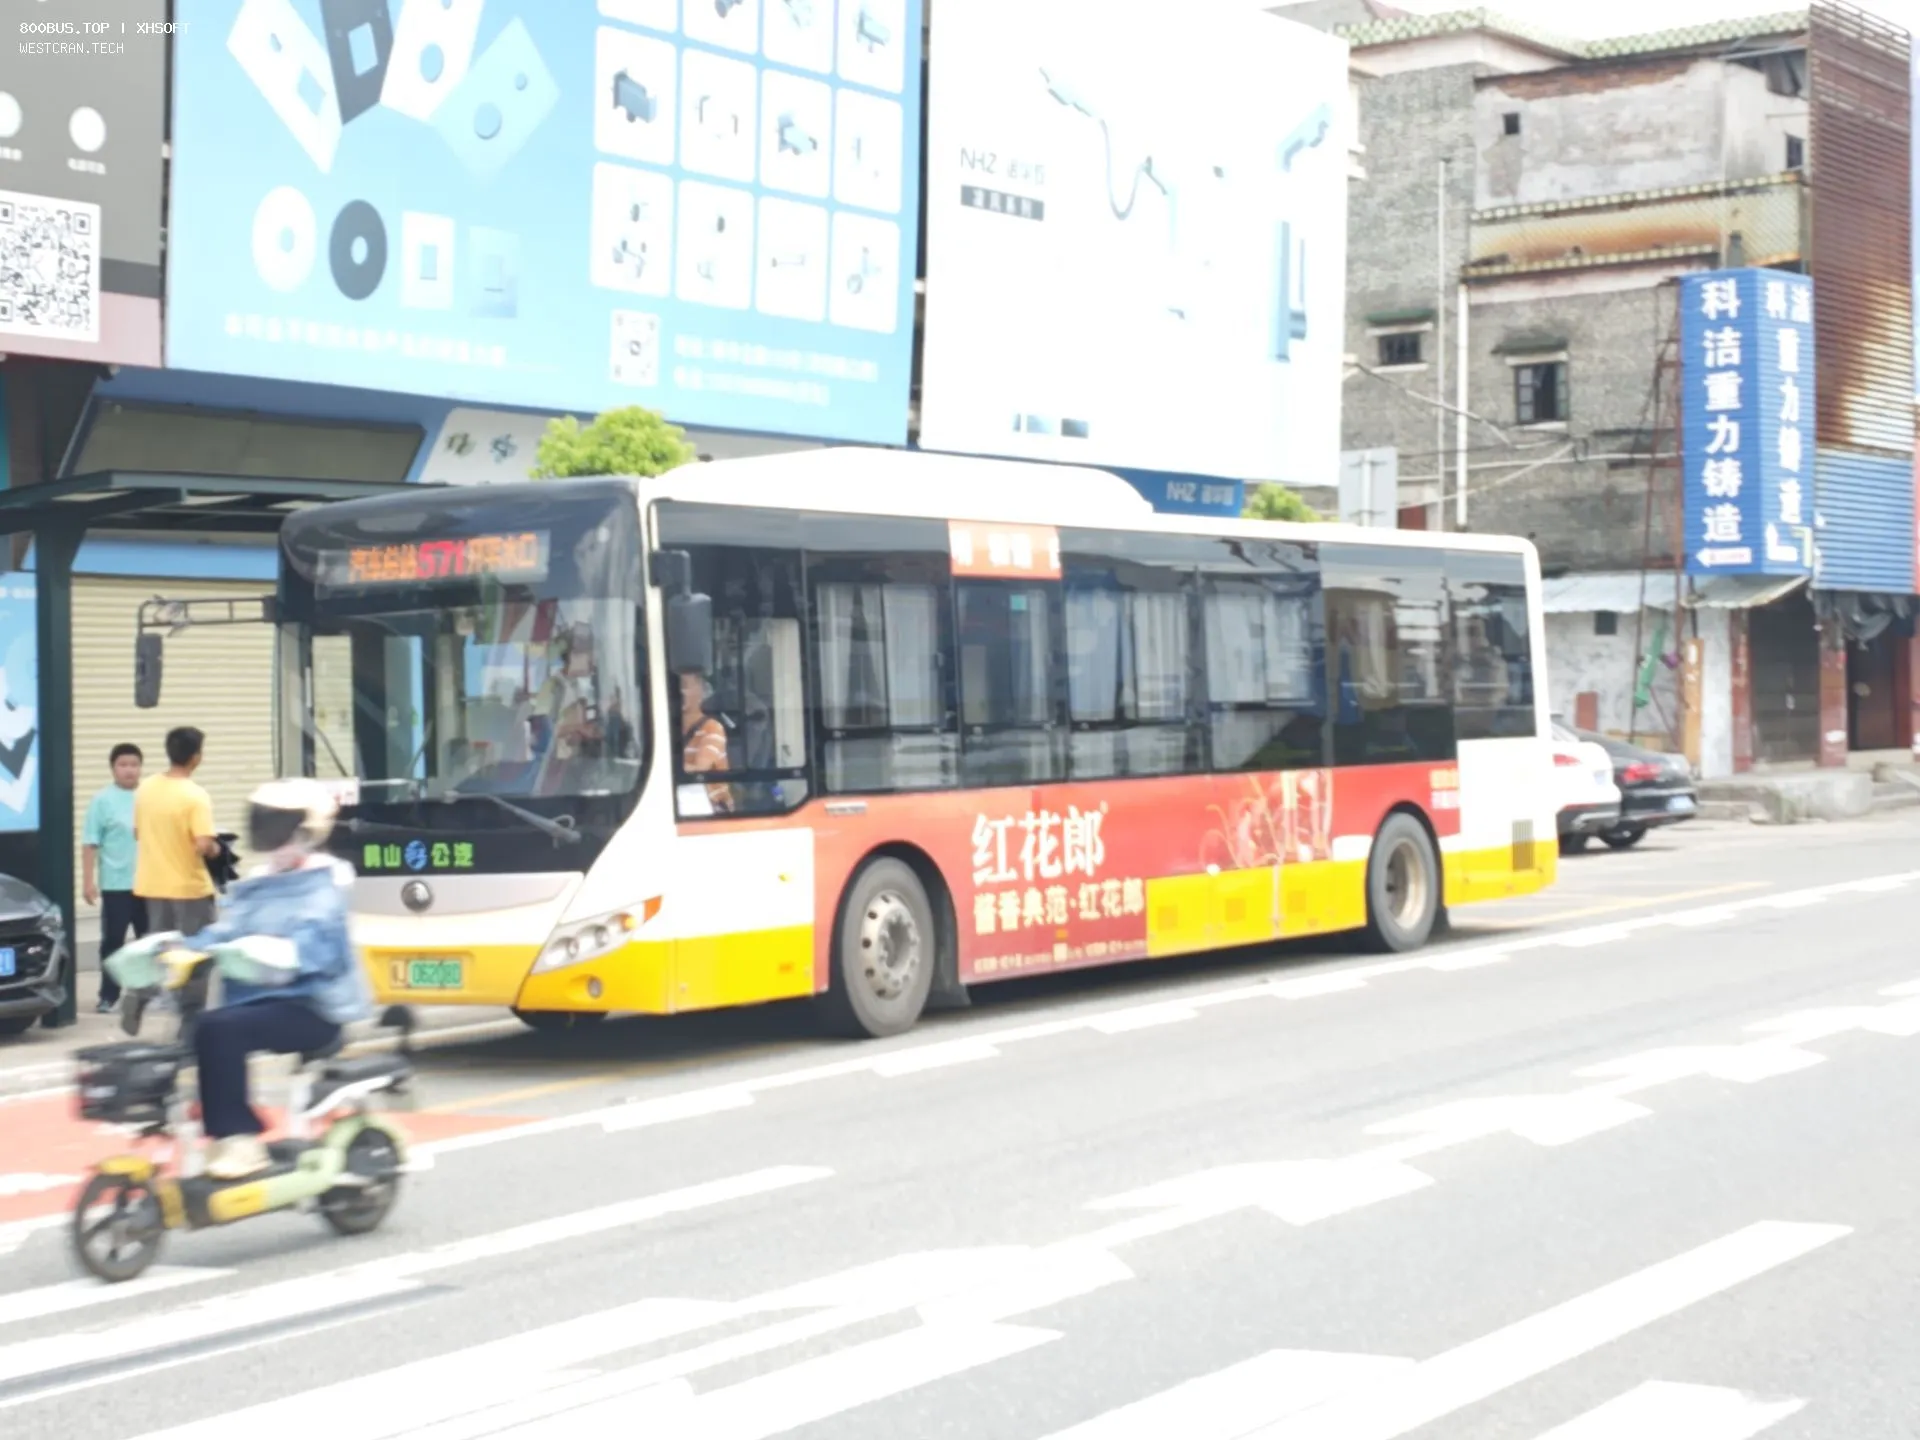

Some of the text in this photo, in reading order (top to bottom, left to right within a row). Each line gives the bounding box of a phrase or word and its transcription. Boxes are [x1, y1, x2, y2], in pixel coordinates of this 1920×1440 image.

[1701, 277, 1742, 542] 科洁重力铸造
[417, 539, 466, 579] 571
[971, 804, 1105, 888] 红花郎
